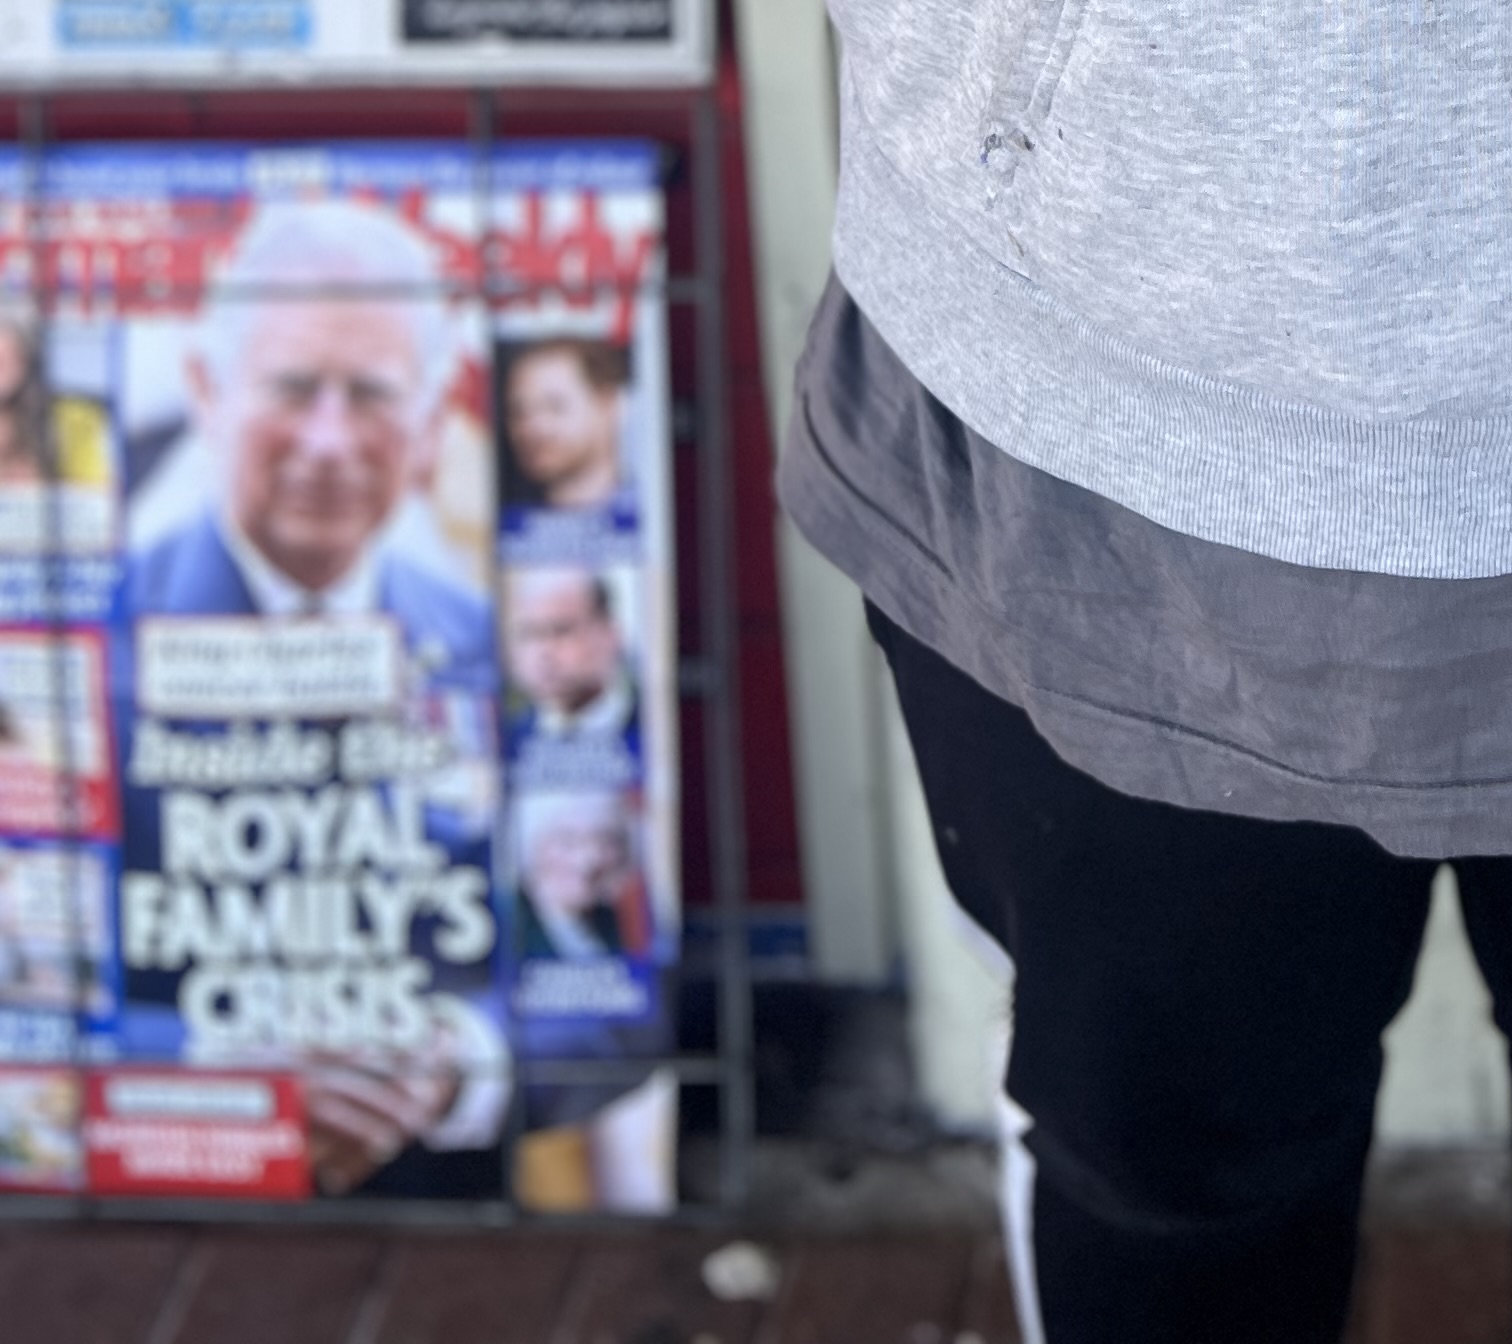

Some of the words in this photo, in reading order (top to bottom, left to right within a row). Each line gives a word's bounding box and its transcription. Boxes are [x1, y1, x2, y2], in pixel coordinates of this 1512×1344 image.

[161, 790, 448, 877] ROYAL
[122, 868, 496, 968] FAMILY'S
[179, 962, 431, 1052] CRISIS
